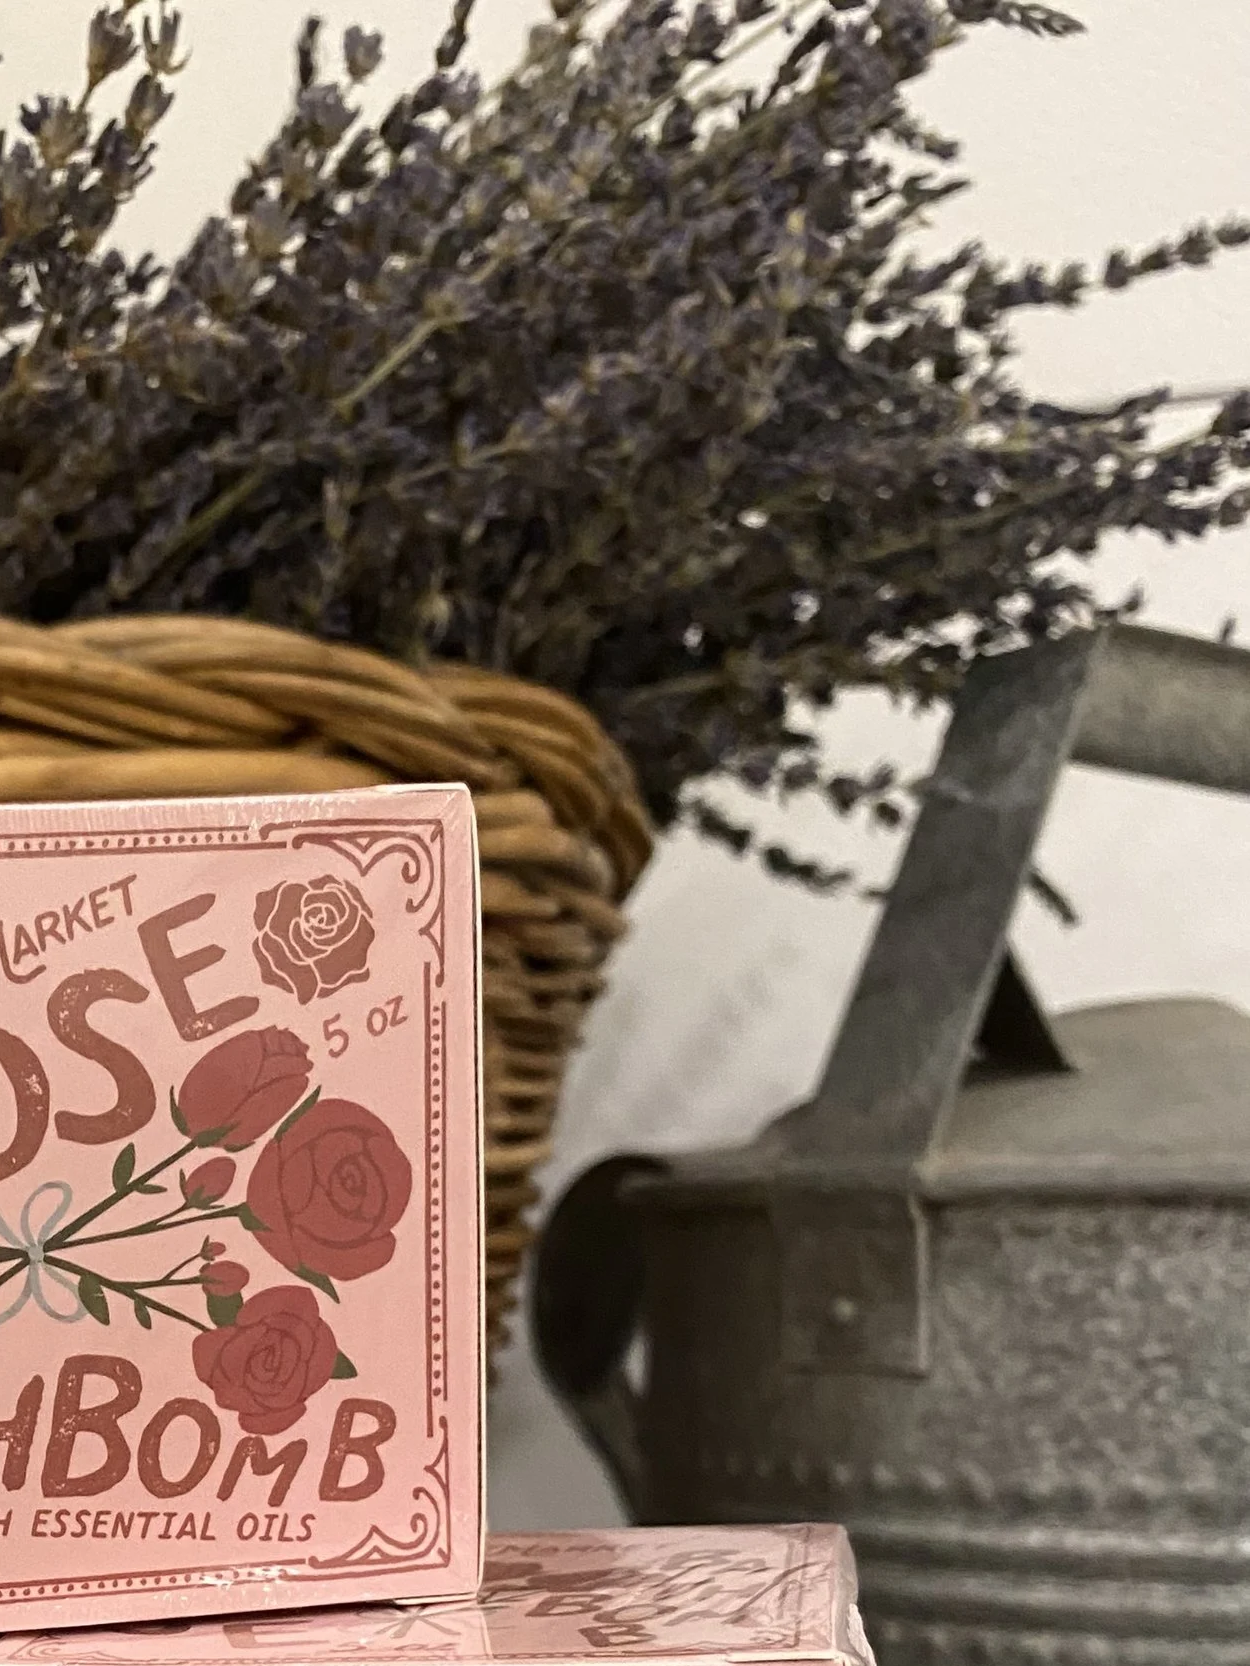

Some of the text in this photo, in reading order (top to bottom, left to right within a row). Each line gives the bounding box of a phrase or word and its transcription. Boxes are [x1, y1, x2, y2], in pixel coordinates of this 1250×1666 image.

[323, 1013, 350, 1059] 5
[30, 1509, 217, 1543] ESSENTIAL
[236, 1511, 317, 1544] OILS
